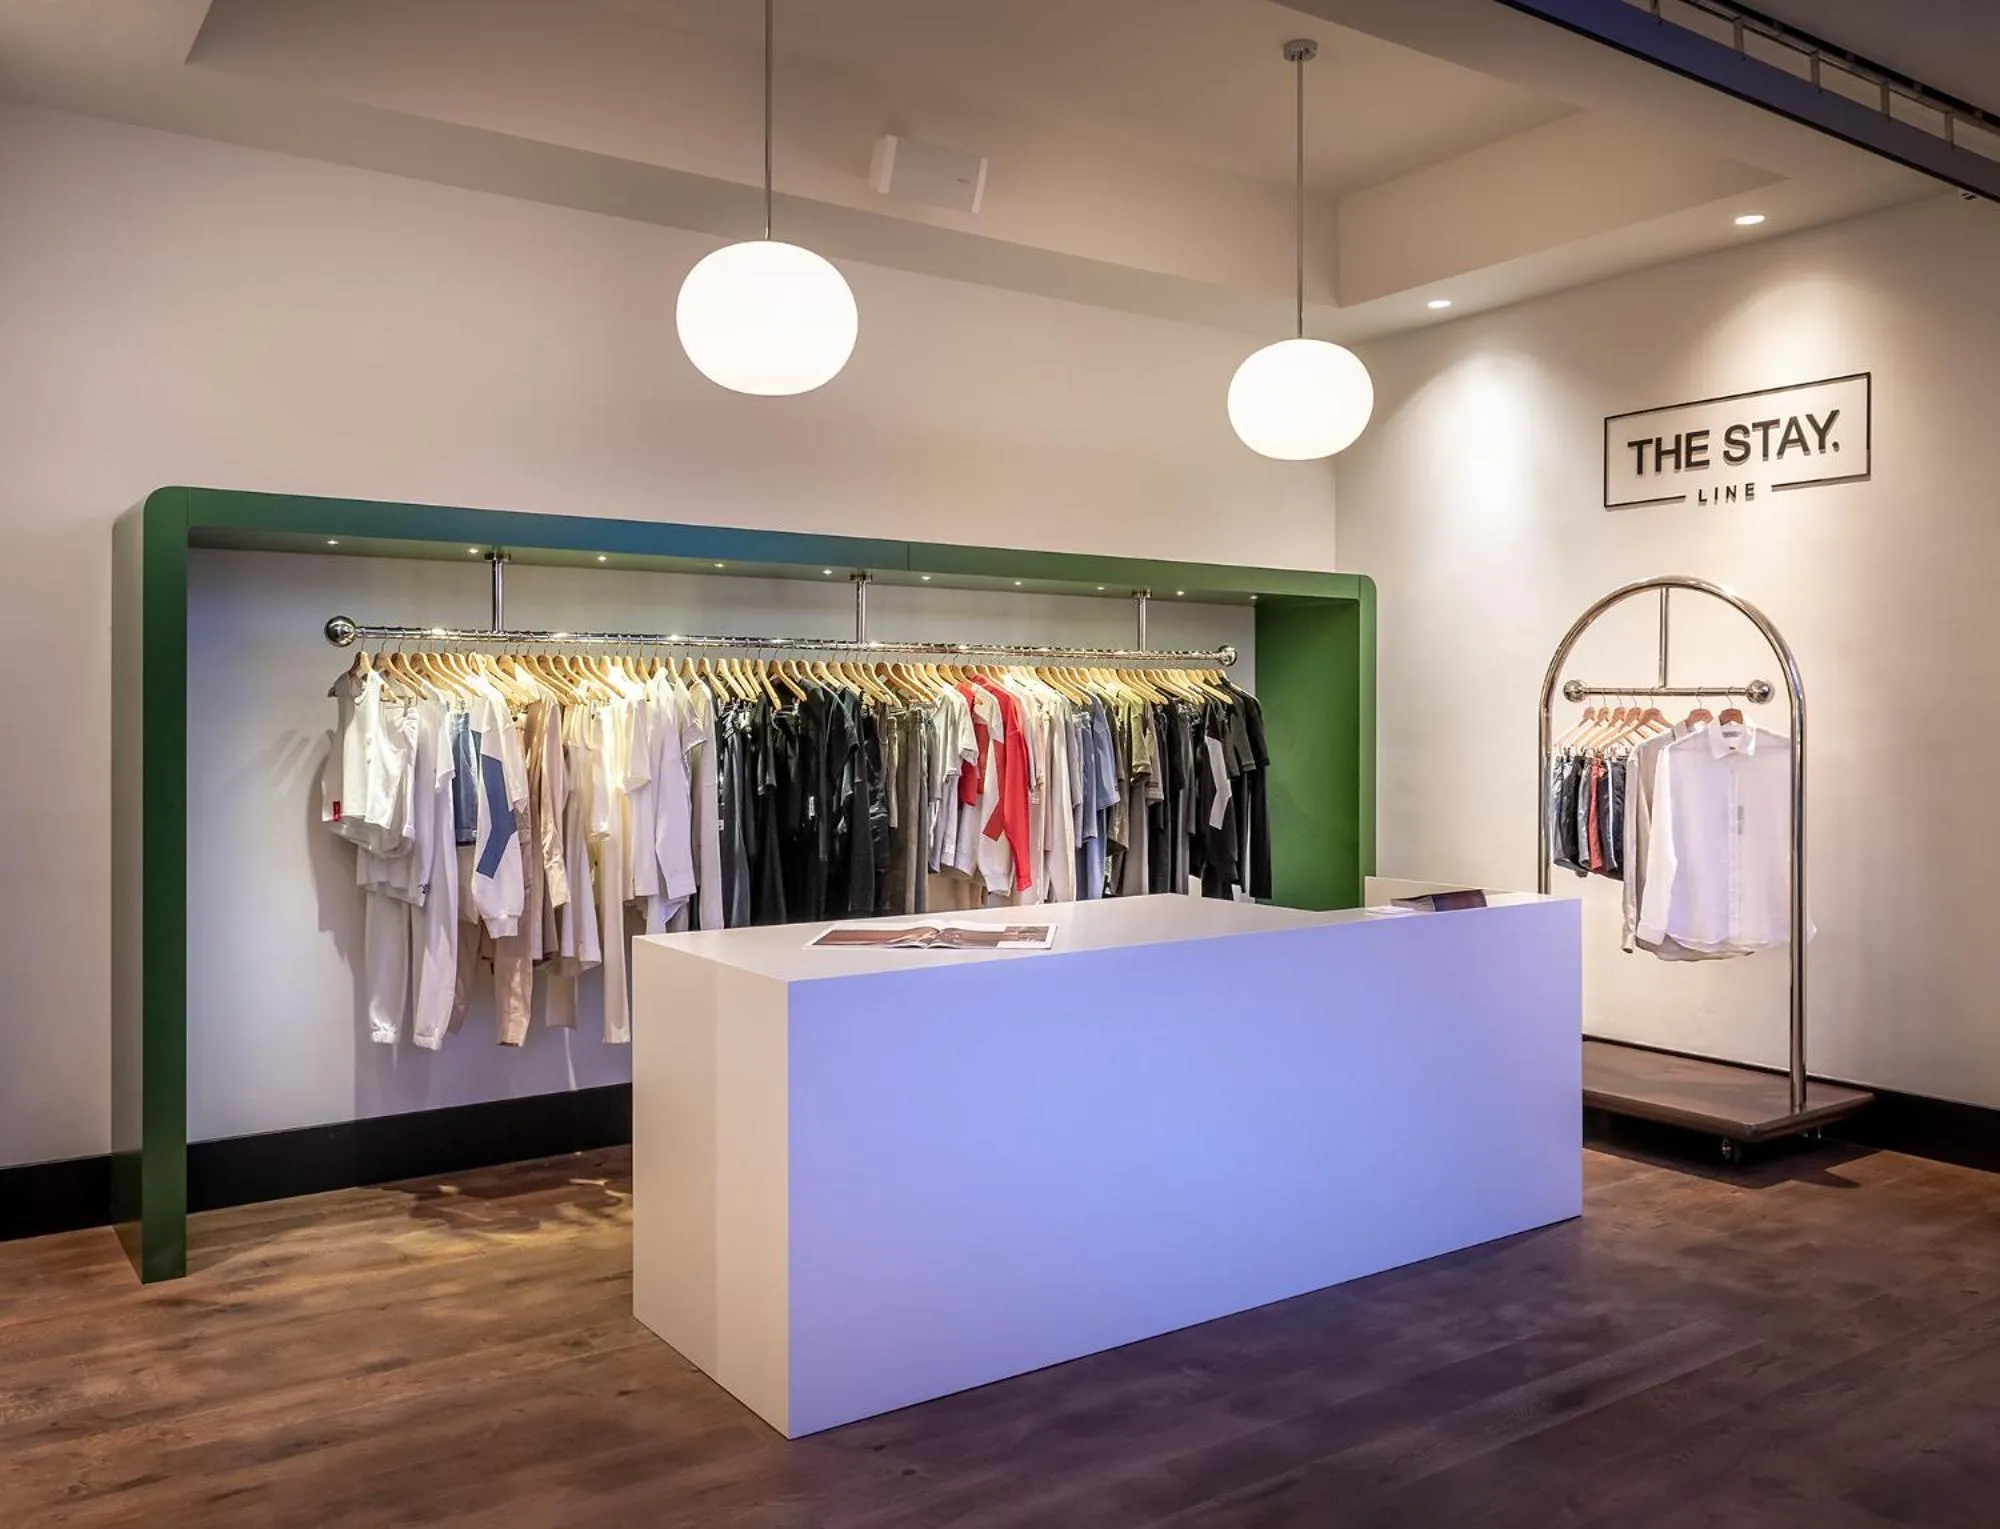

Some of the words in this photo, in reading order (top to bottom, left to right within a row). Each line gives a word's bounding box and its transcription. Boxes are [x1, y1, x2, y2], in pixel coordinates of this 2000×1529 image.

[1627, 430, 1710, 475] THE
[1723, 409, 1840, 465] STAY.
[1698, 483, 1755, 506] LINE
